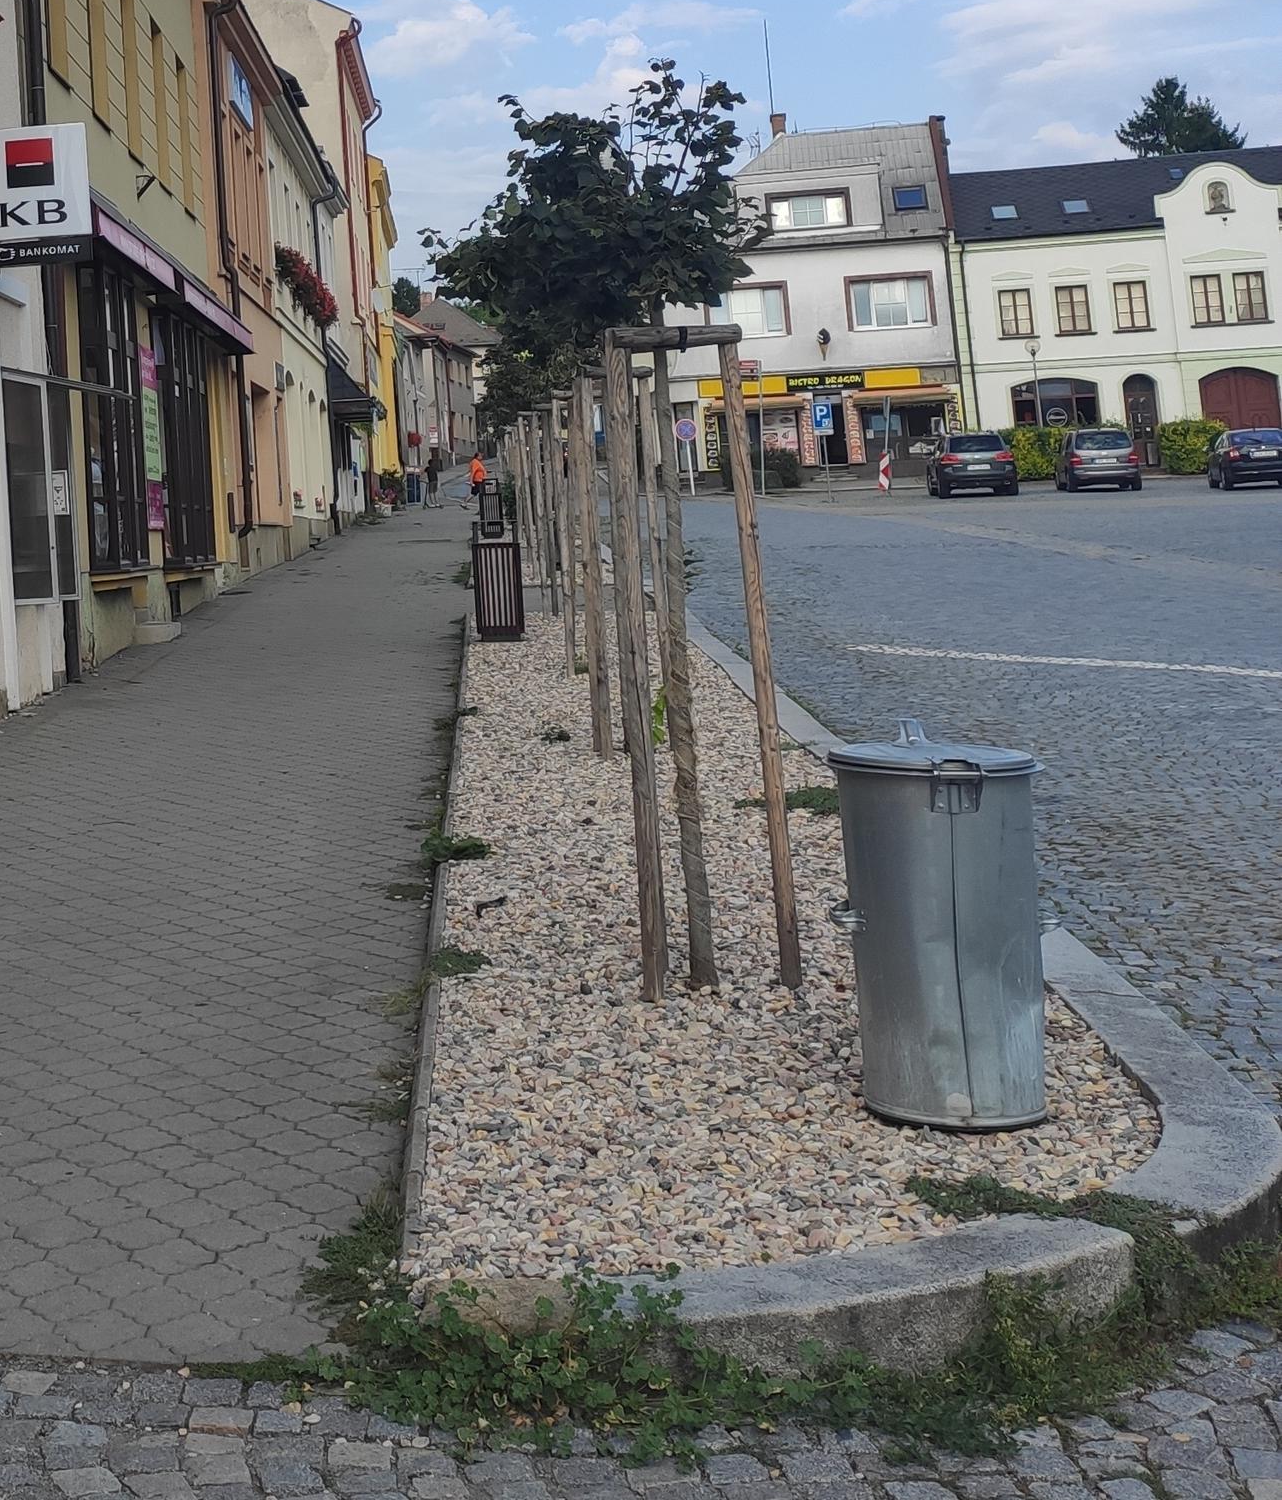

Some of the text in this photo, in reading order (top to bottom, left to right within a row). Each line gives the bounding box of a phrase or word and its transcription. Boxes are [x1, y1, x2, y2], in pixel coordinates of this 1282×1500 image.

[19, 244, 81, 257] BANKOMAT
[788, 377, 820, 387] BISTRO
[824, 374, 862, 385] DRAGON
[817, 405, 828, 421] P
